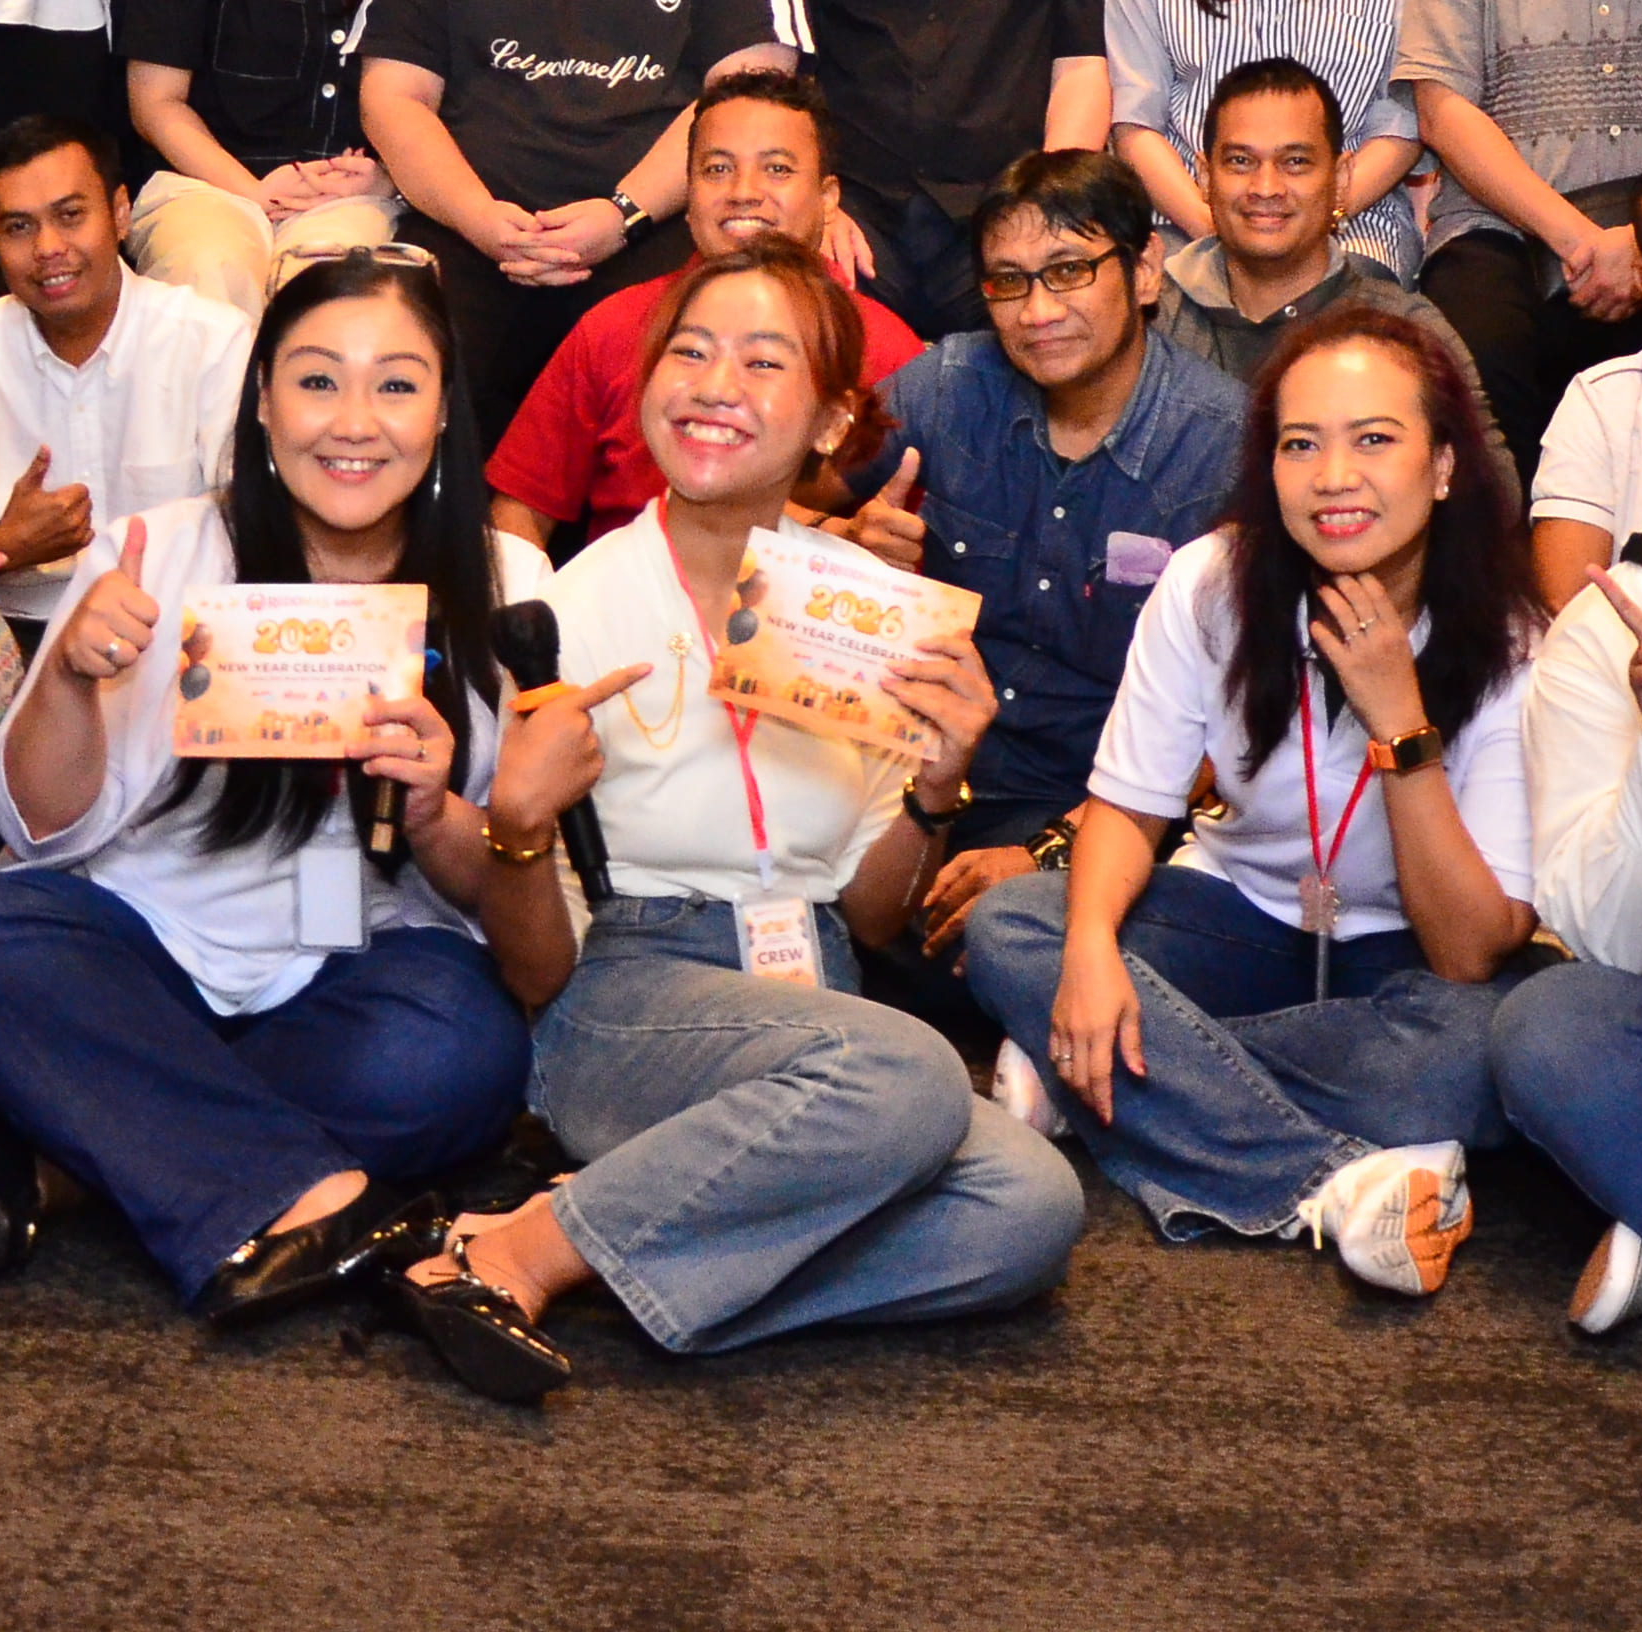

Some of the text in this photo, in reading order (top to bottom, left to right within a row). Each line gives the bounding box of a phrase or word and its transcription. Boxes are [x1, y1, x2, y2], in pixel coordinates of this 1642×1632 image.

[491, 38, 537, 70] Let
[525, 55, 637, 88] yourself
[805, 583, 905, 641] 2026
[253, 617, 357, 655] 2026
[767, 615, 797, 633] NEW
[802, 624, 835, 643] YEAR
[839, 636, 906, 661] CELEBRAT
[217, 662, 387, 673] NEW YEAR CELEBRATION
[757, 947, 803, 965] CREW
